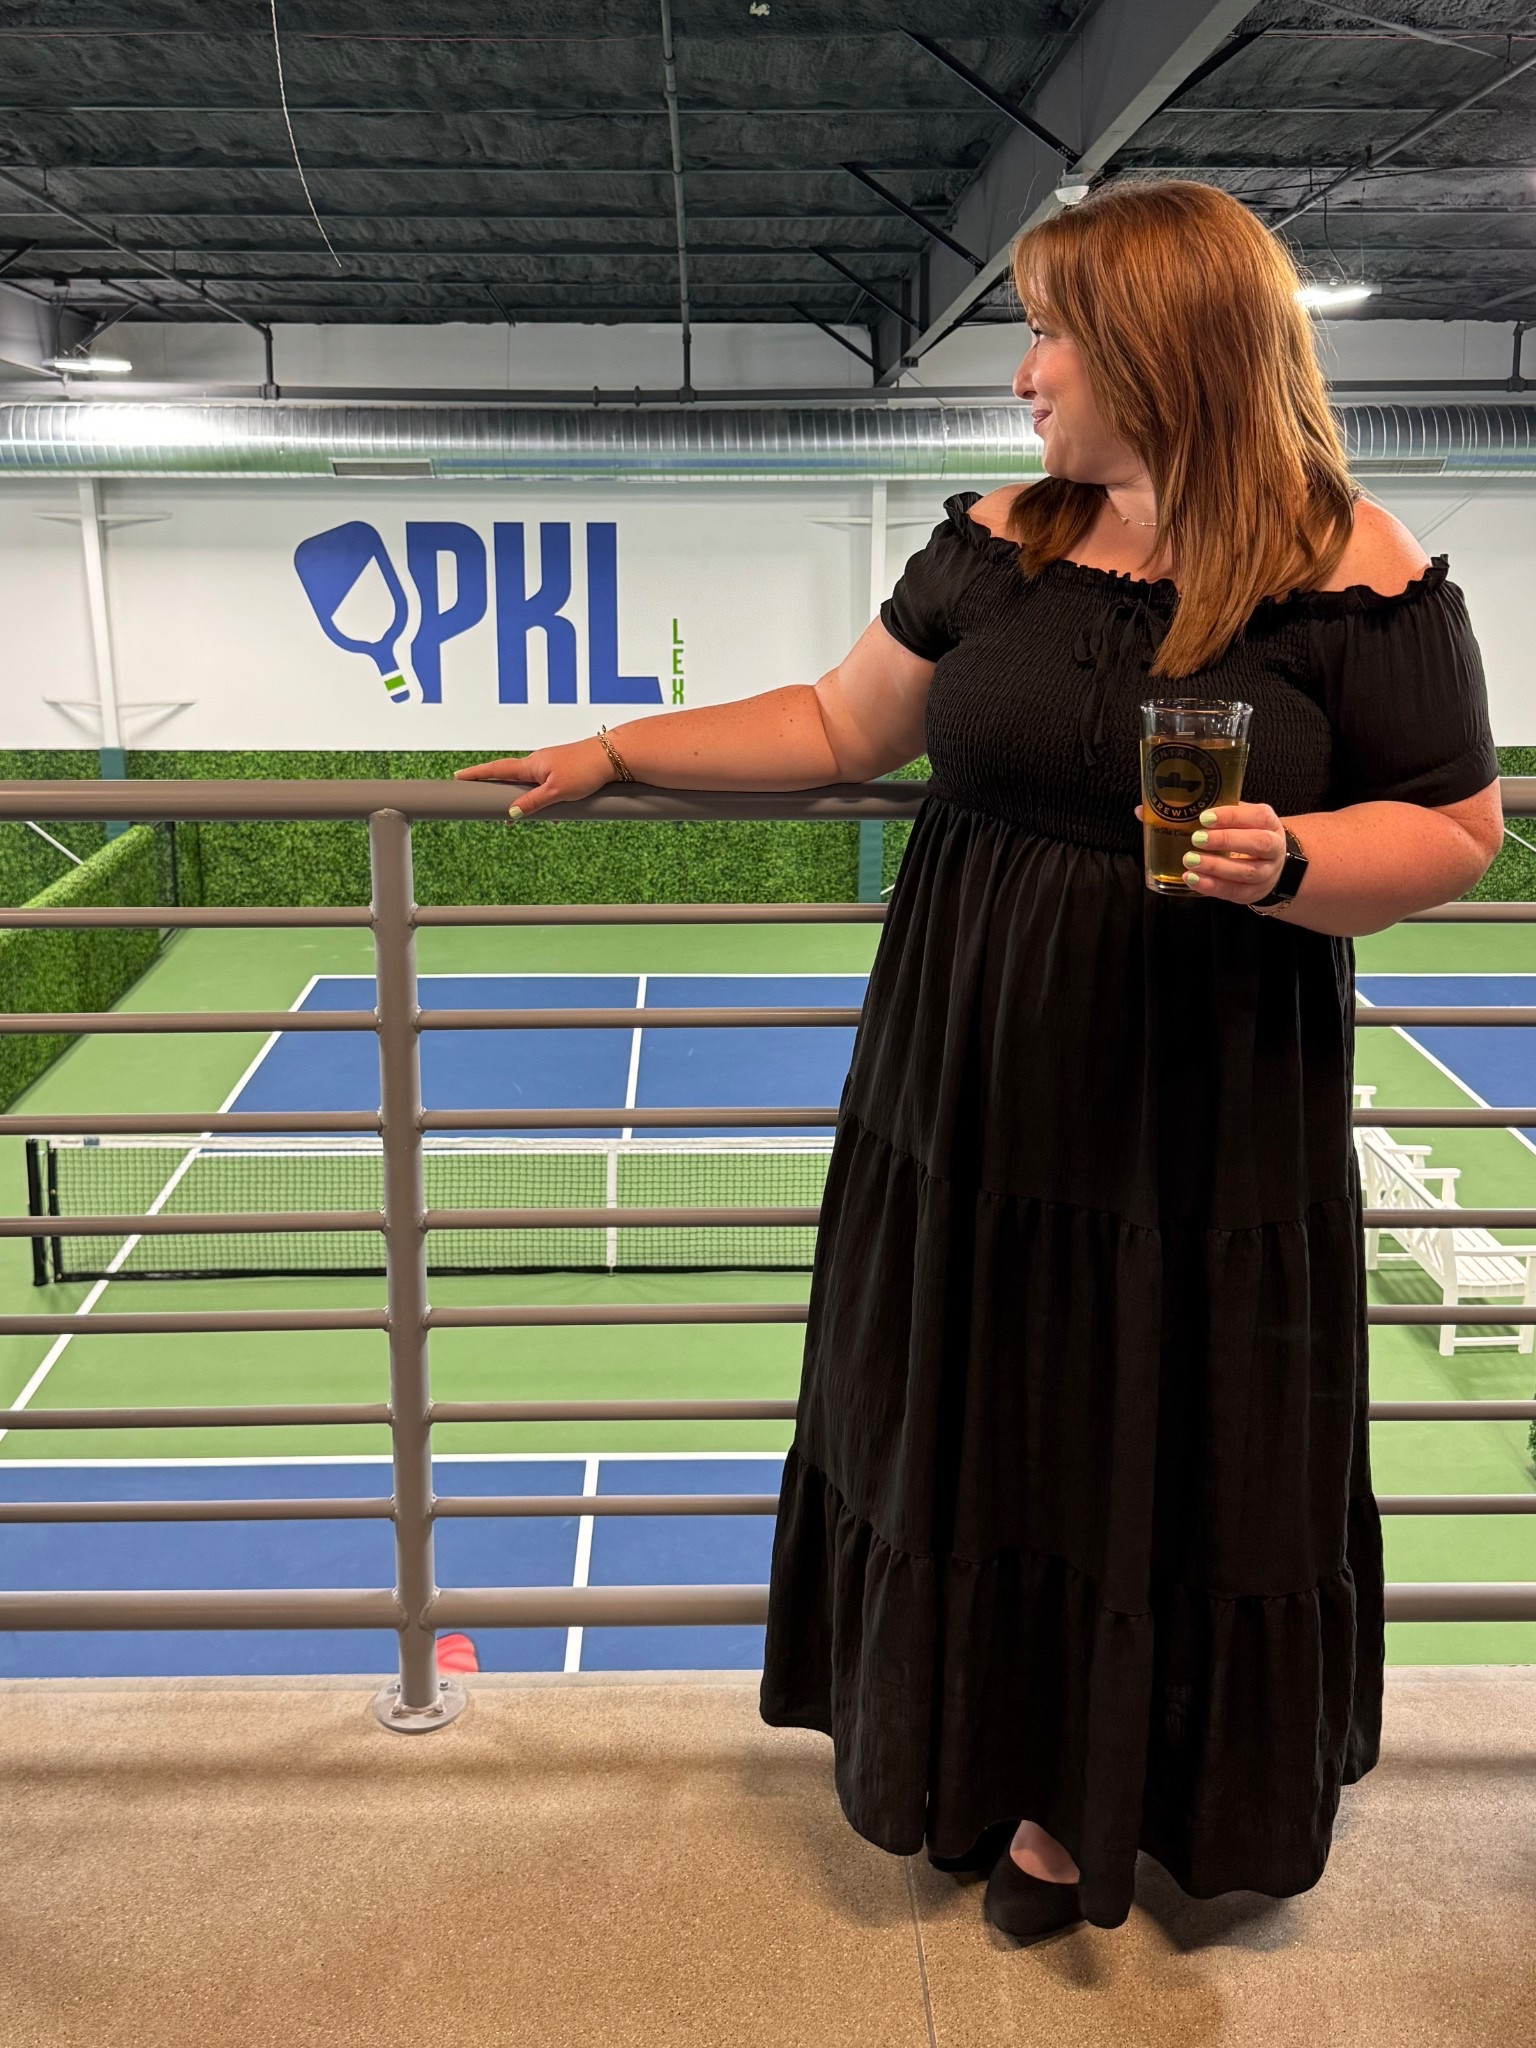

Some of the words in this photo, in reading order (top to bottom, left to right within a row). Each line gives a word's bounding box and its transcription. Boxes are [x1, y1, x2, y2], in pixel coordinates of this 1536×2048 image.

[406, 521, 664, 704] PKL
[672, 618, 684, 704] LEX
[1148, 748, 1196, 774] OUNTRY
[1151, 795, 1206, 817] BREWING
